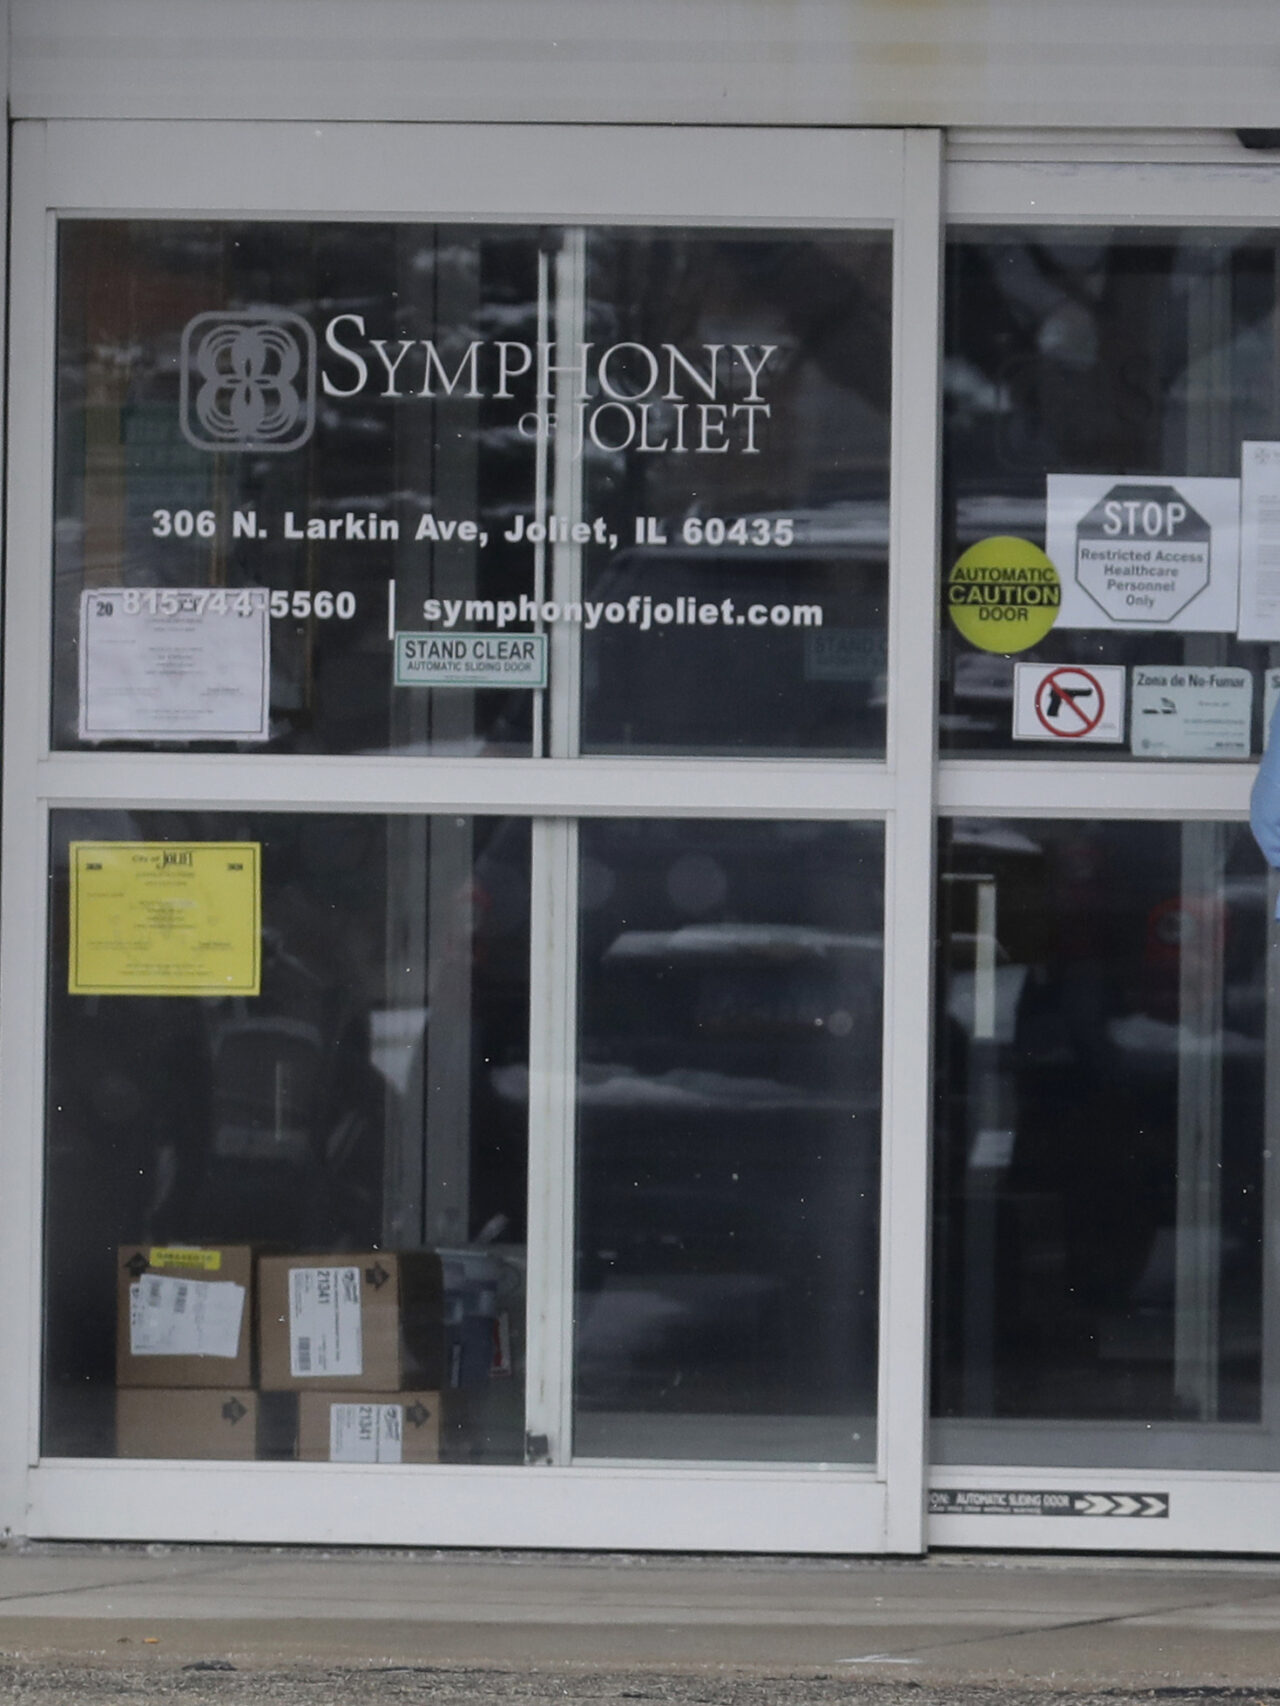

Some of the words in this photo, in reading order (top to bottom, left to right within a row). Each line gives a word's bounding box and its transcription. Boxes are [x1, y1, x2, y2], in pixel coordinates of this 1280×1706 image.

[323, 314, 777, 402] SYMPHONY
[573, 402, 772, 459] JOLIET
[1103, 500, 1187, 537] STOP
[151, 509, 216, 539] 306
[232, 511, 268, 540] N.
[284, 512, 400, 541] Larkin
[414, 513, 489, 549] Ave,
[504, 515, 618, 550] Joliet,
[634, 517, 667, 546] IL
[682, 518, 795, 548] 60435
[1081, 549, 1151, 563] Restricted
[1155, 550, 1204, 564] Access
[954, 567, 1056, 584] AUTOMATIC
[1104, 564, 1179, 578] Healthcare
[949, 585, 1061, 606] CAUTION
[1107, 579, 1176, 593] Personnel
[121, 589, 357, 621] 815-744-5560
[1125, 593, 1156, 609] Only
[422, 595, 824, 630] symphonyofjoliet.com
[978, 606, 1029, 622] DOOR
[405, 640, 467, 659] STAND
[472, 641, 535, 660] CLEAR
[407, 660, 461, 672] AUTOMATIC
[464, 662, 502, 672] SLIDING
[504, 663, 532, 673] DOOR
[1137, 674, 1168, 687] Zona
[1171, 674, 1186, 687] de
[317, 1270, 330, 1304] 21341
[359, 1407, 372, 1441] 21341
[956, 1493, 1007, 1506] AUTOMATIC
[1008, 1494, 1041, 1506] SLIDING
[1043, 1494, 1069, 1507] DOOR
